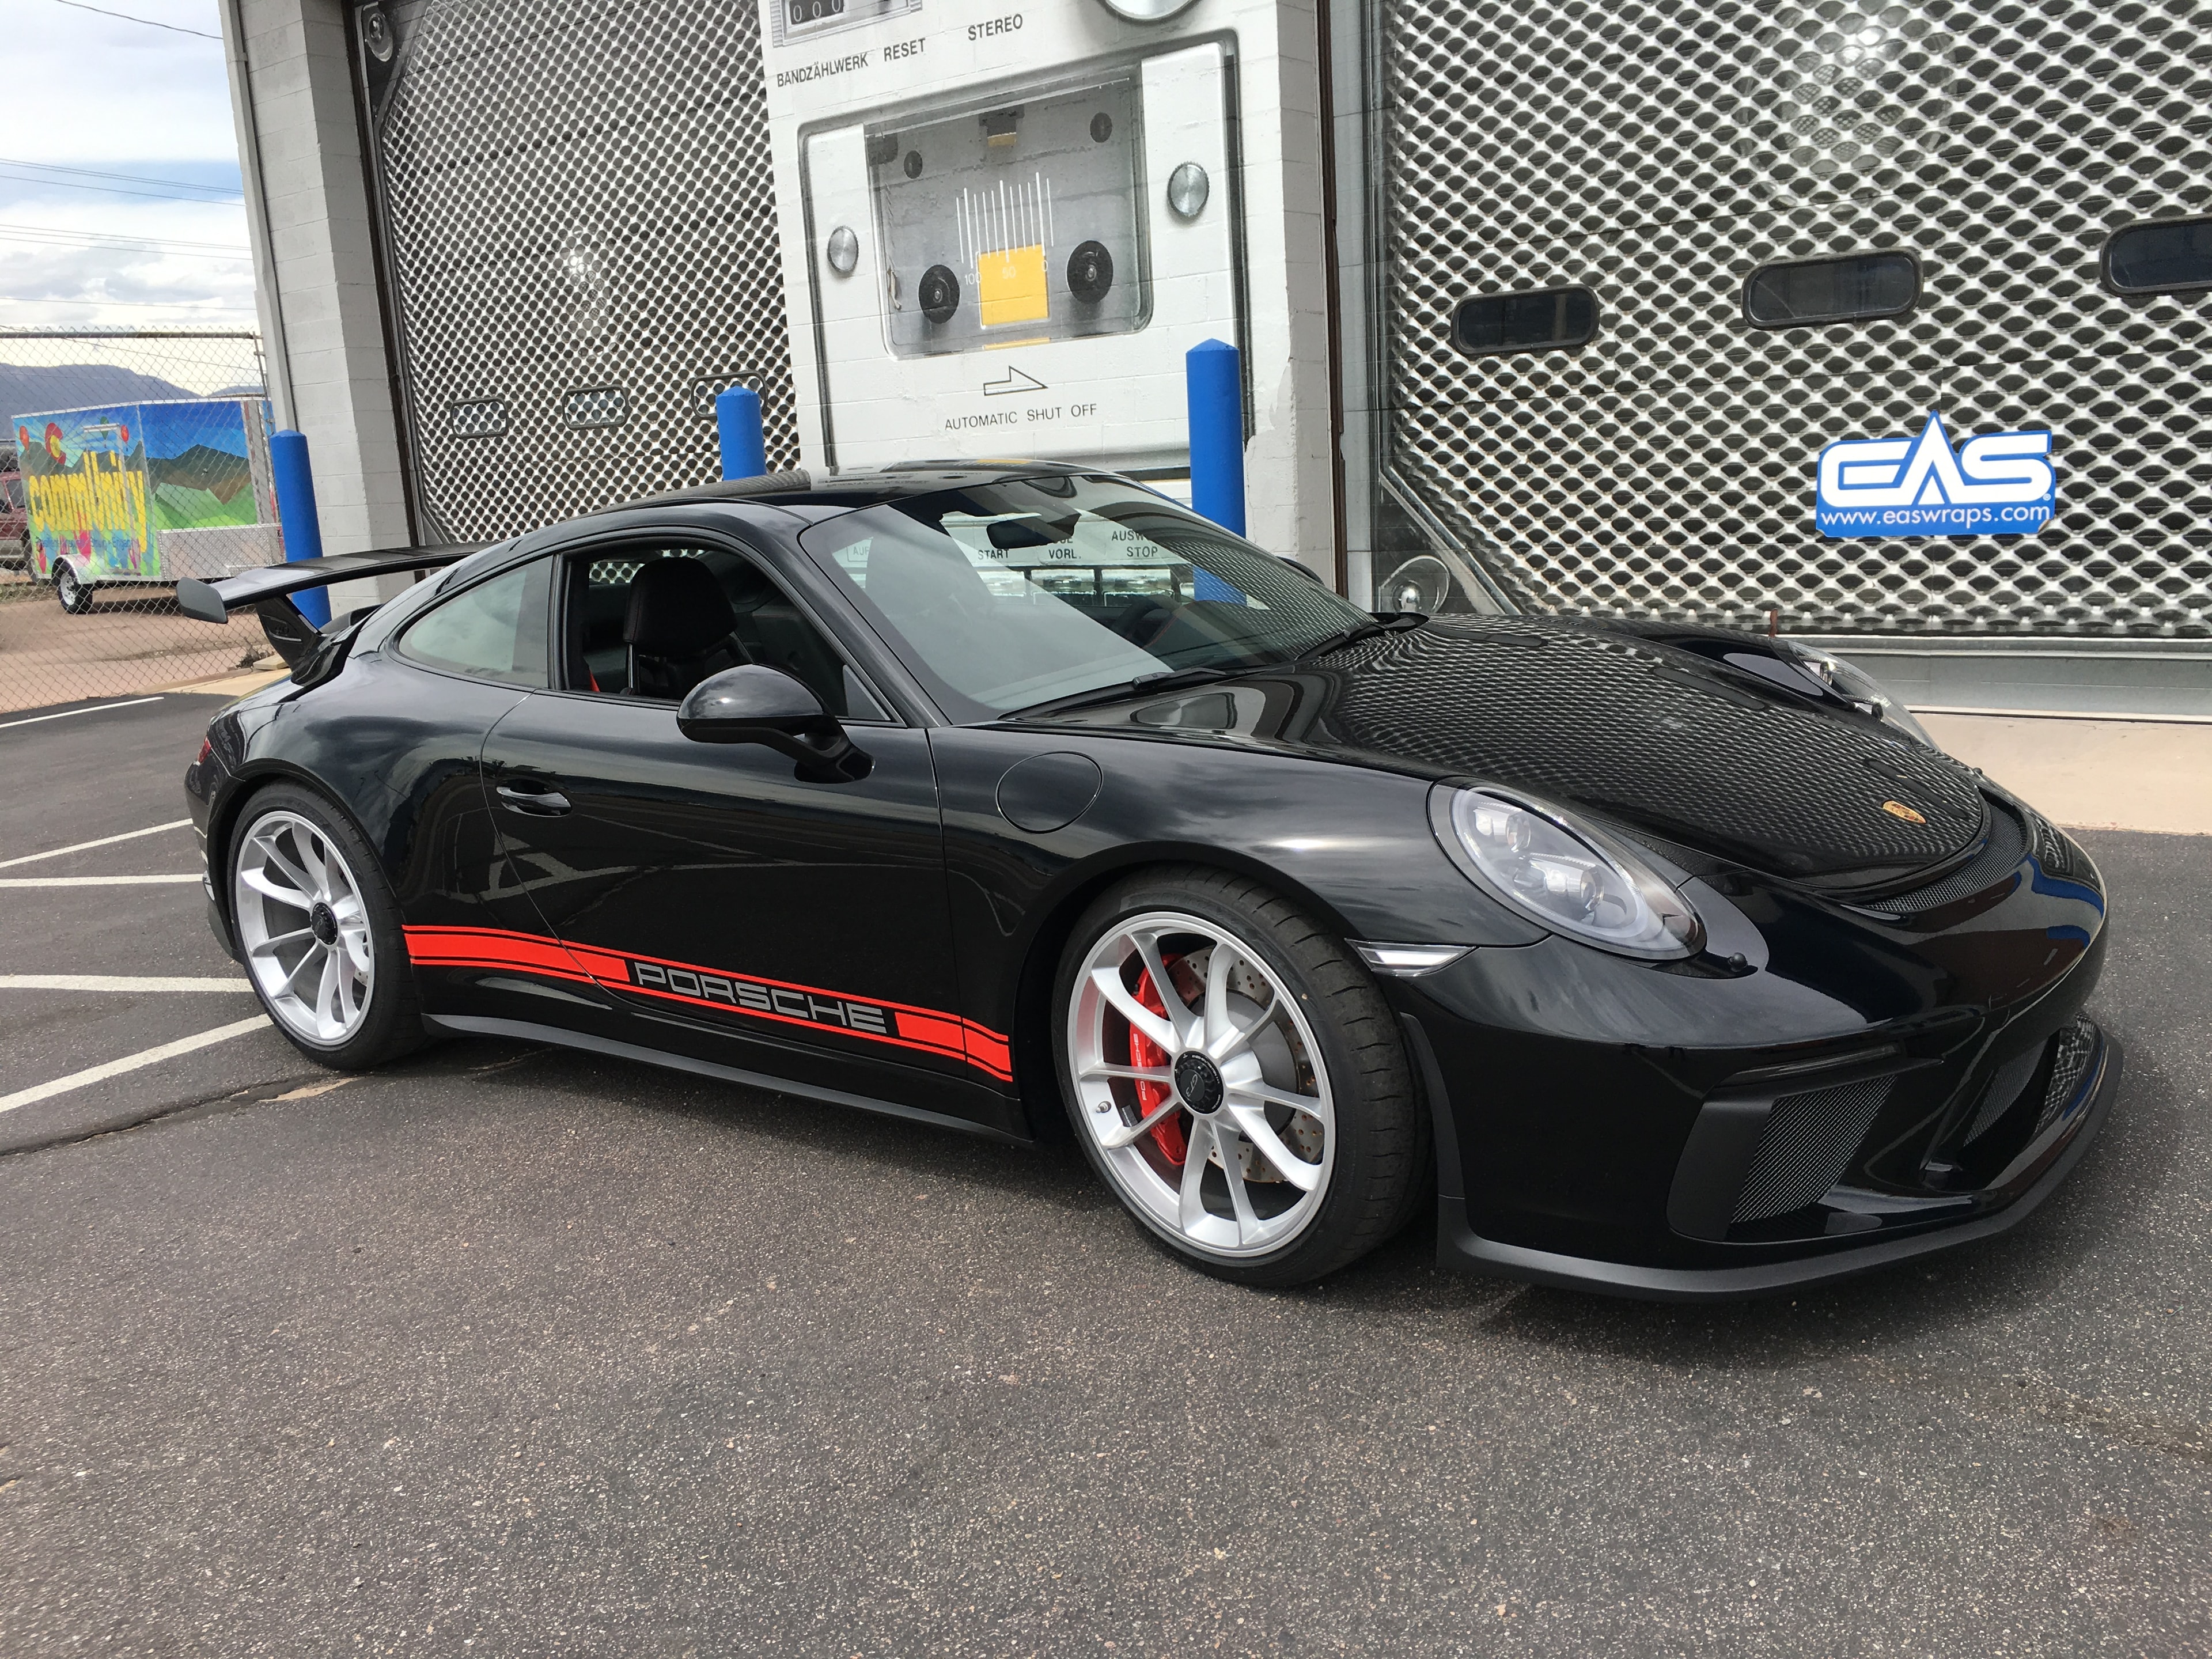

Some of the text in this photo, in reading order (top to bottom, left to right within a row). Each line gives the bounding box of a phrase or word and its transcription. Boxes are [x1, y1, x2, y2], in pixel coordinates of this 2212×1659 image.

[968, 13, 1022, 41] STEREO
[777, 37, 926, 87] BANDZÄHLWERK RESET
[965, 260, 1048, 286] 100 50 0
[945, 403, 1097, 430] AUTOMATIC SHUT OFF
[1820, 416, 2052, 507] EAS
[29, 450, 147, 553] community
[1820, 505, 2051, 529] www.easwraps.com
[978, 549, 1009, 560] START
[1048, 548, 1081, 560] VORL.
[1126, 546, 1158, 558] STOP
[634, 961, 887, 1034] PORSCHE
[1185, 1073, 1198, 1097] GT3
